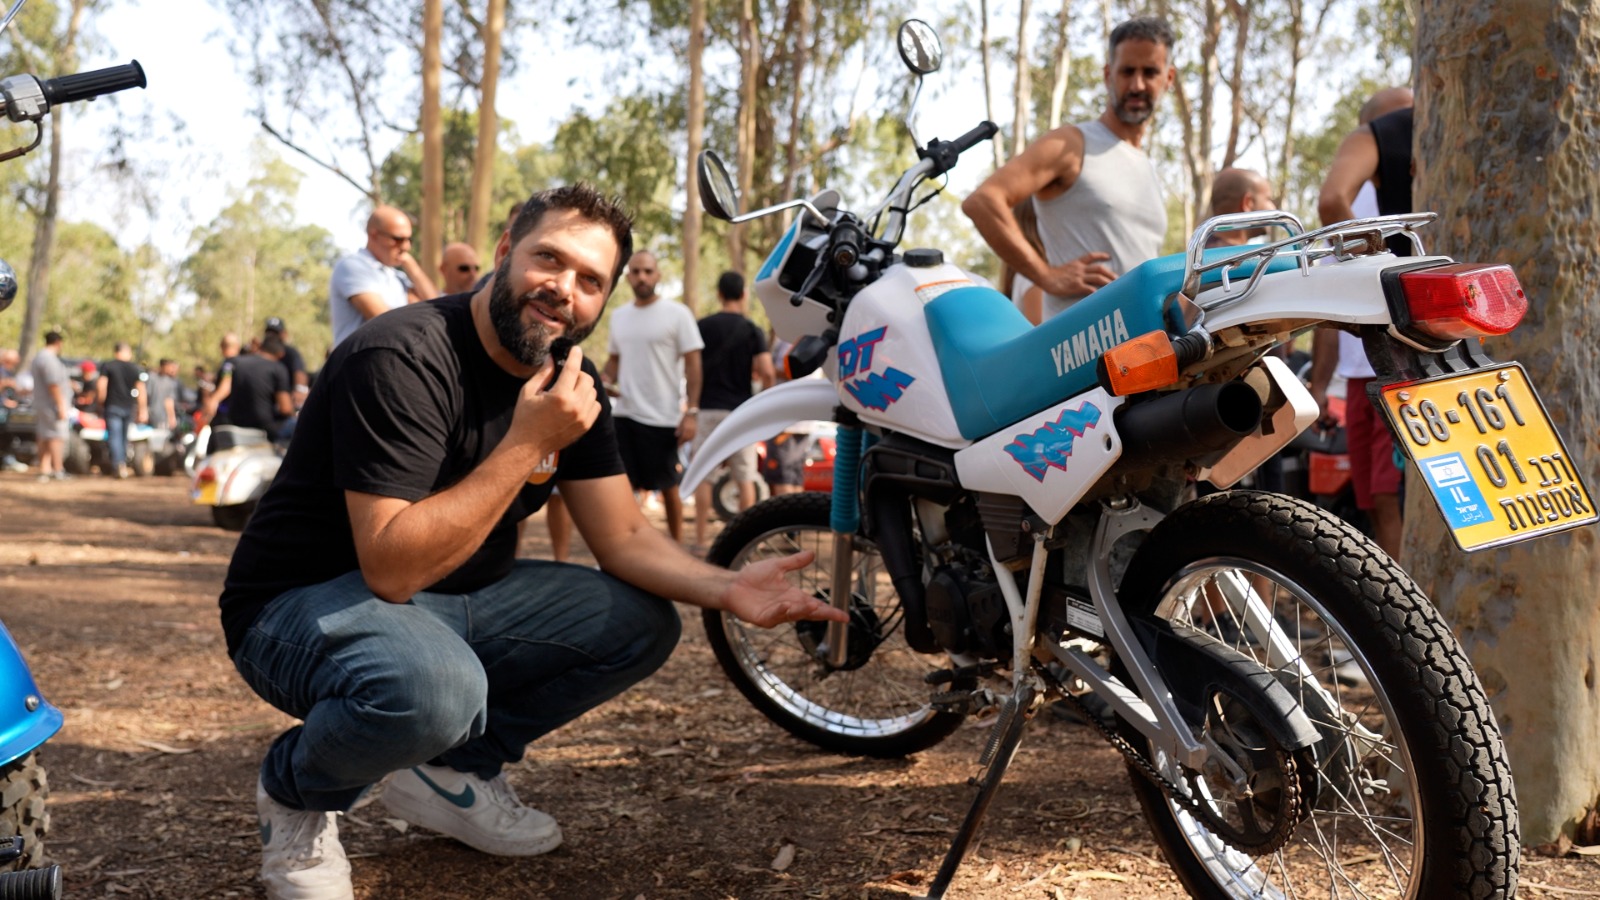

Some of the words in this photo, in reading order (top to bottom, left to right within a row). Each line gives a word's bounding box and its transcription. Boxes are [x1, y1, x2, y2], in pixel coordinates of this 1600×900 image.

[838, 325, 888, 382] DT
[1050, 308, 1130, 377] YAMAHA
[1399, 383, 1525, 446] 68-161
[1476, 440, 1527, 488] 01
[1529, 452, 1574, 487] רכב
[1450, 486, 1471, 504] IL
[1498, 483, 1590, 531] אספנות
